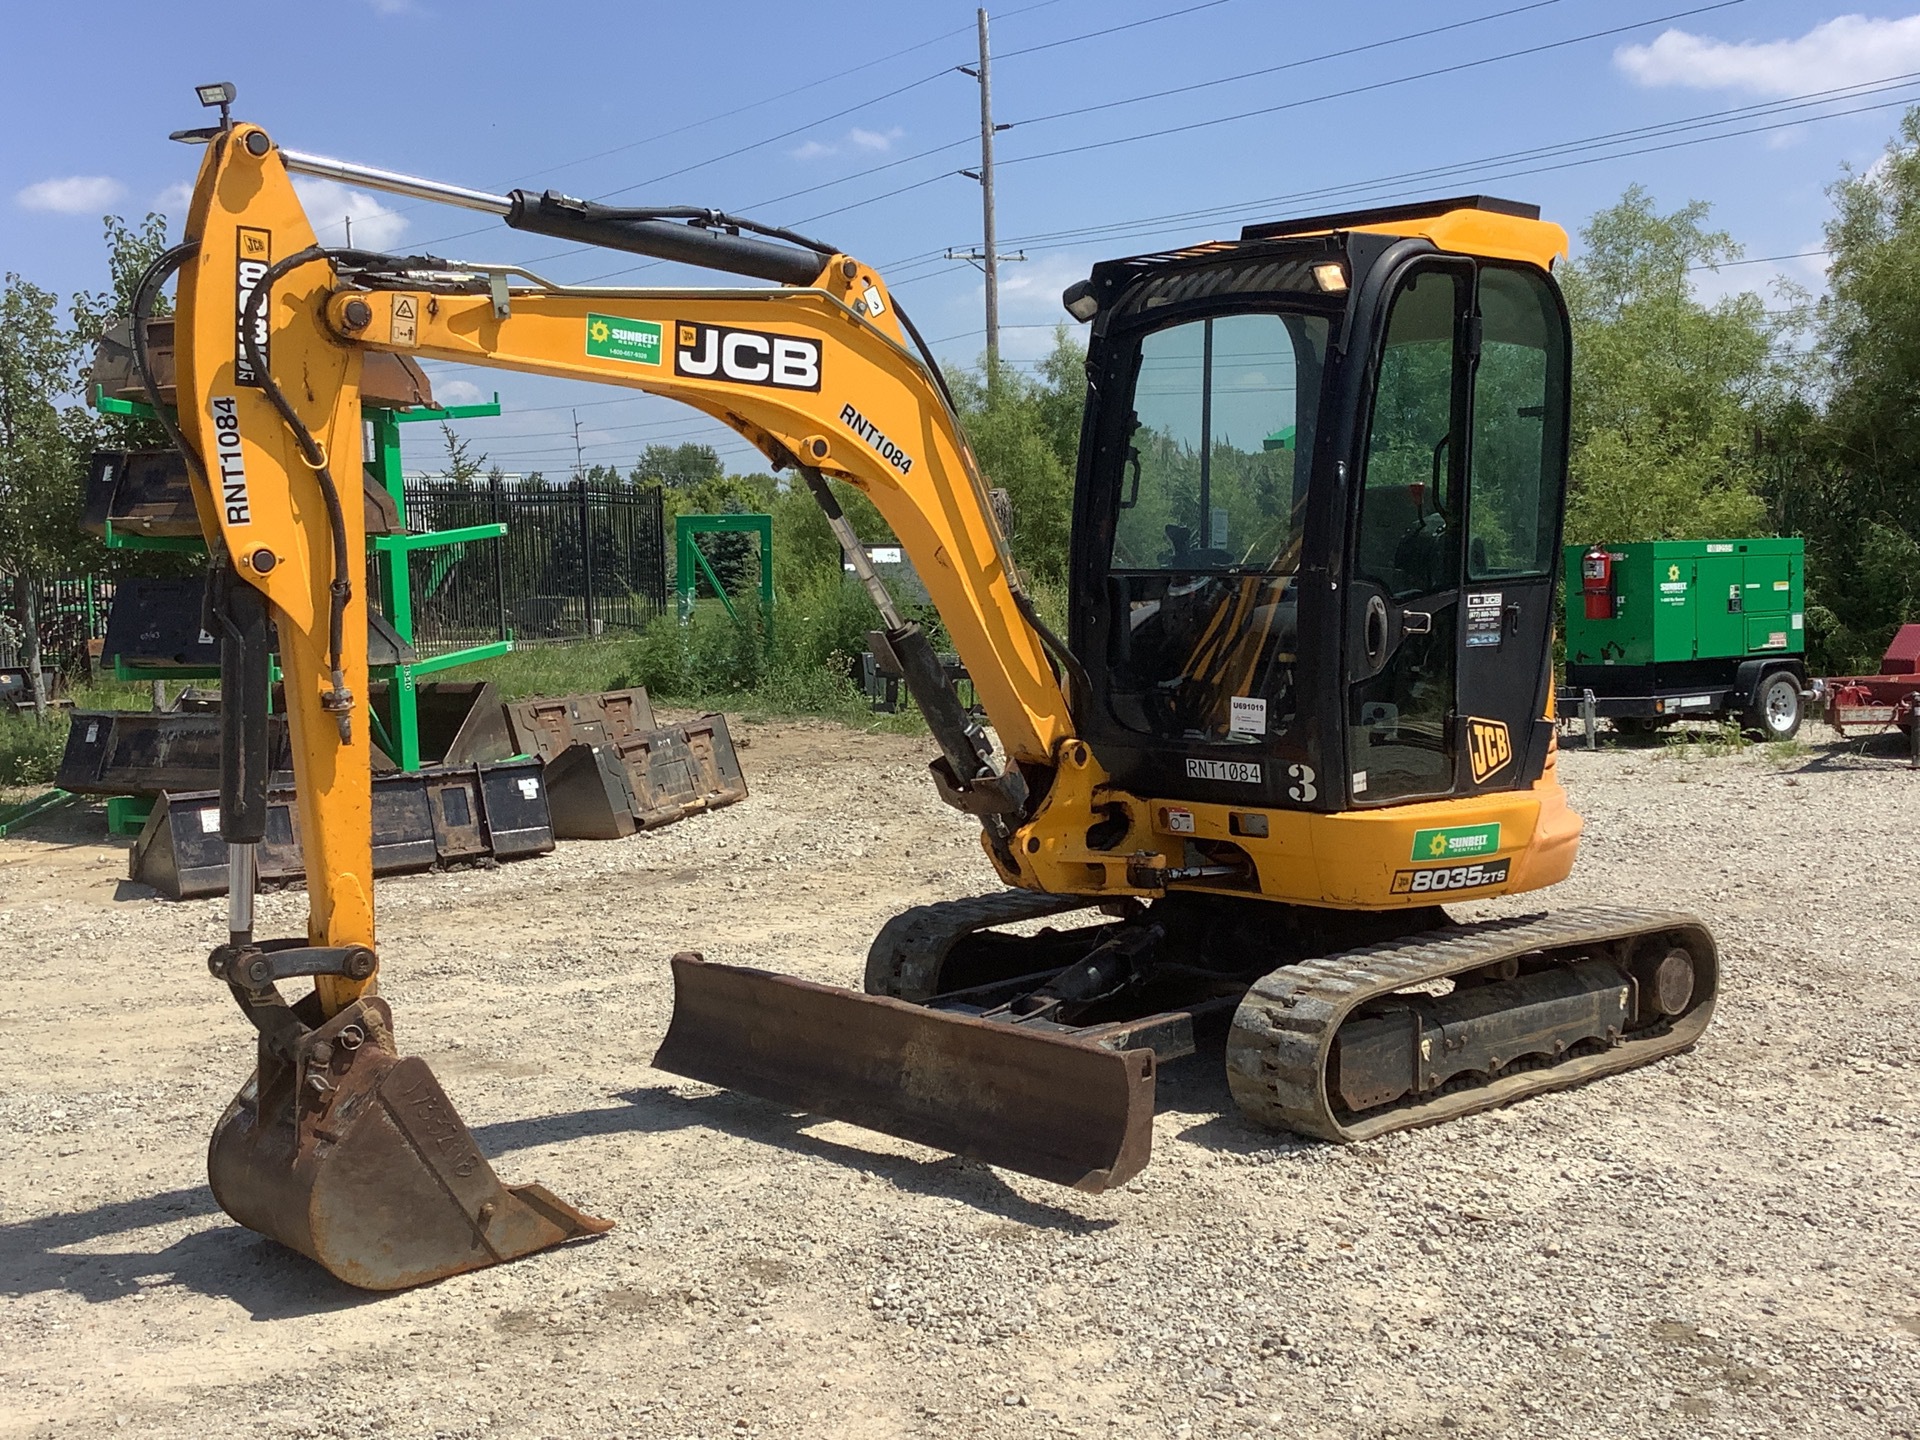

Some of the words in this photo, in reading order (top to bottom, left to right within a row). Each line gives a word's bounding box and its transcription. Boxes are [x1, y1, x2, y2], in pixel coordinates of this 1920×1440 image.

[611, 328, 659, 345] SUNBELT
[617, 339, 652, 348] RENTALS
[679, 329, 818, 387] JCB
[839, 403, 913, 475] RNT1084
[213, 397, 251, 524] RNT1084
[1233, 702, 1264, 711] U691019
[1473, 724, 1508, 776] JCB
[1188, 760, 1260, 782] RNT1084
[1288, 764, 1318, 802] 3
[1449, 834, 1488, 849] SUNBELT
[1412, 865, 1484, 891] 8035
[1481, 869, 1506, 884] ZTS
